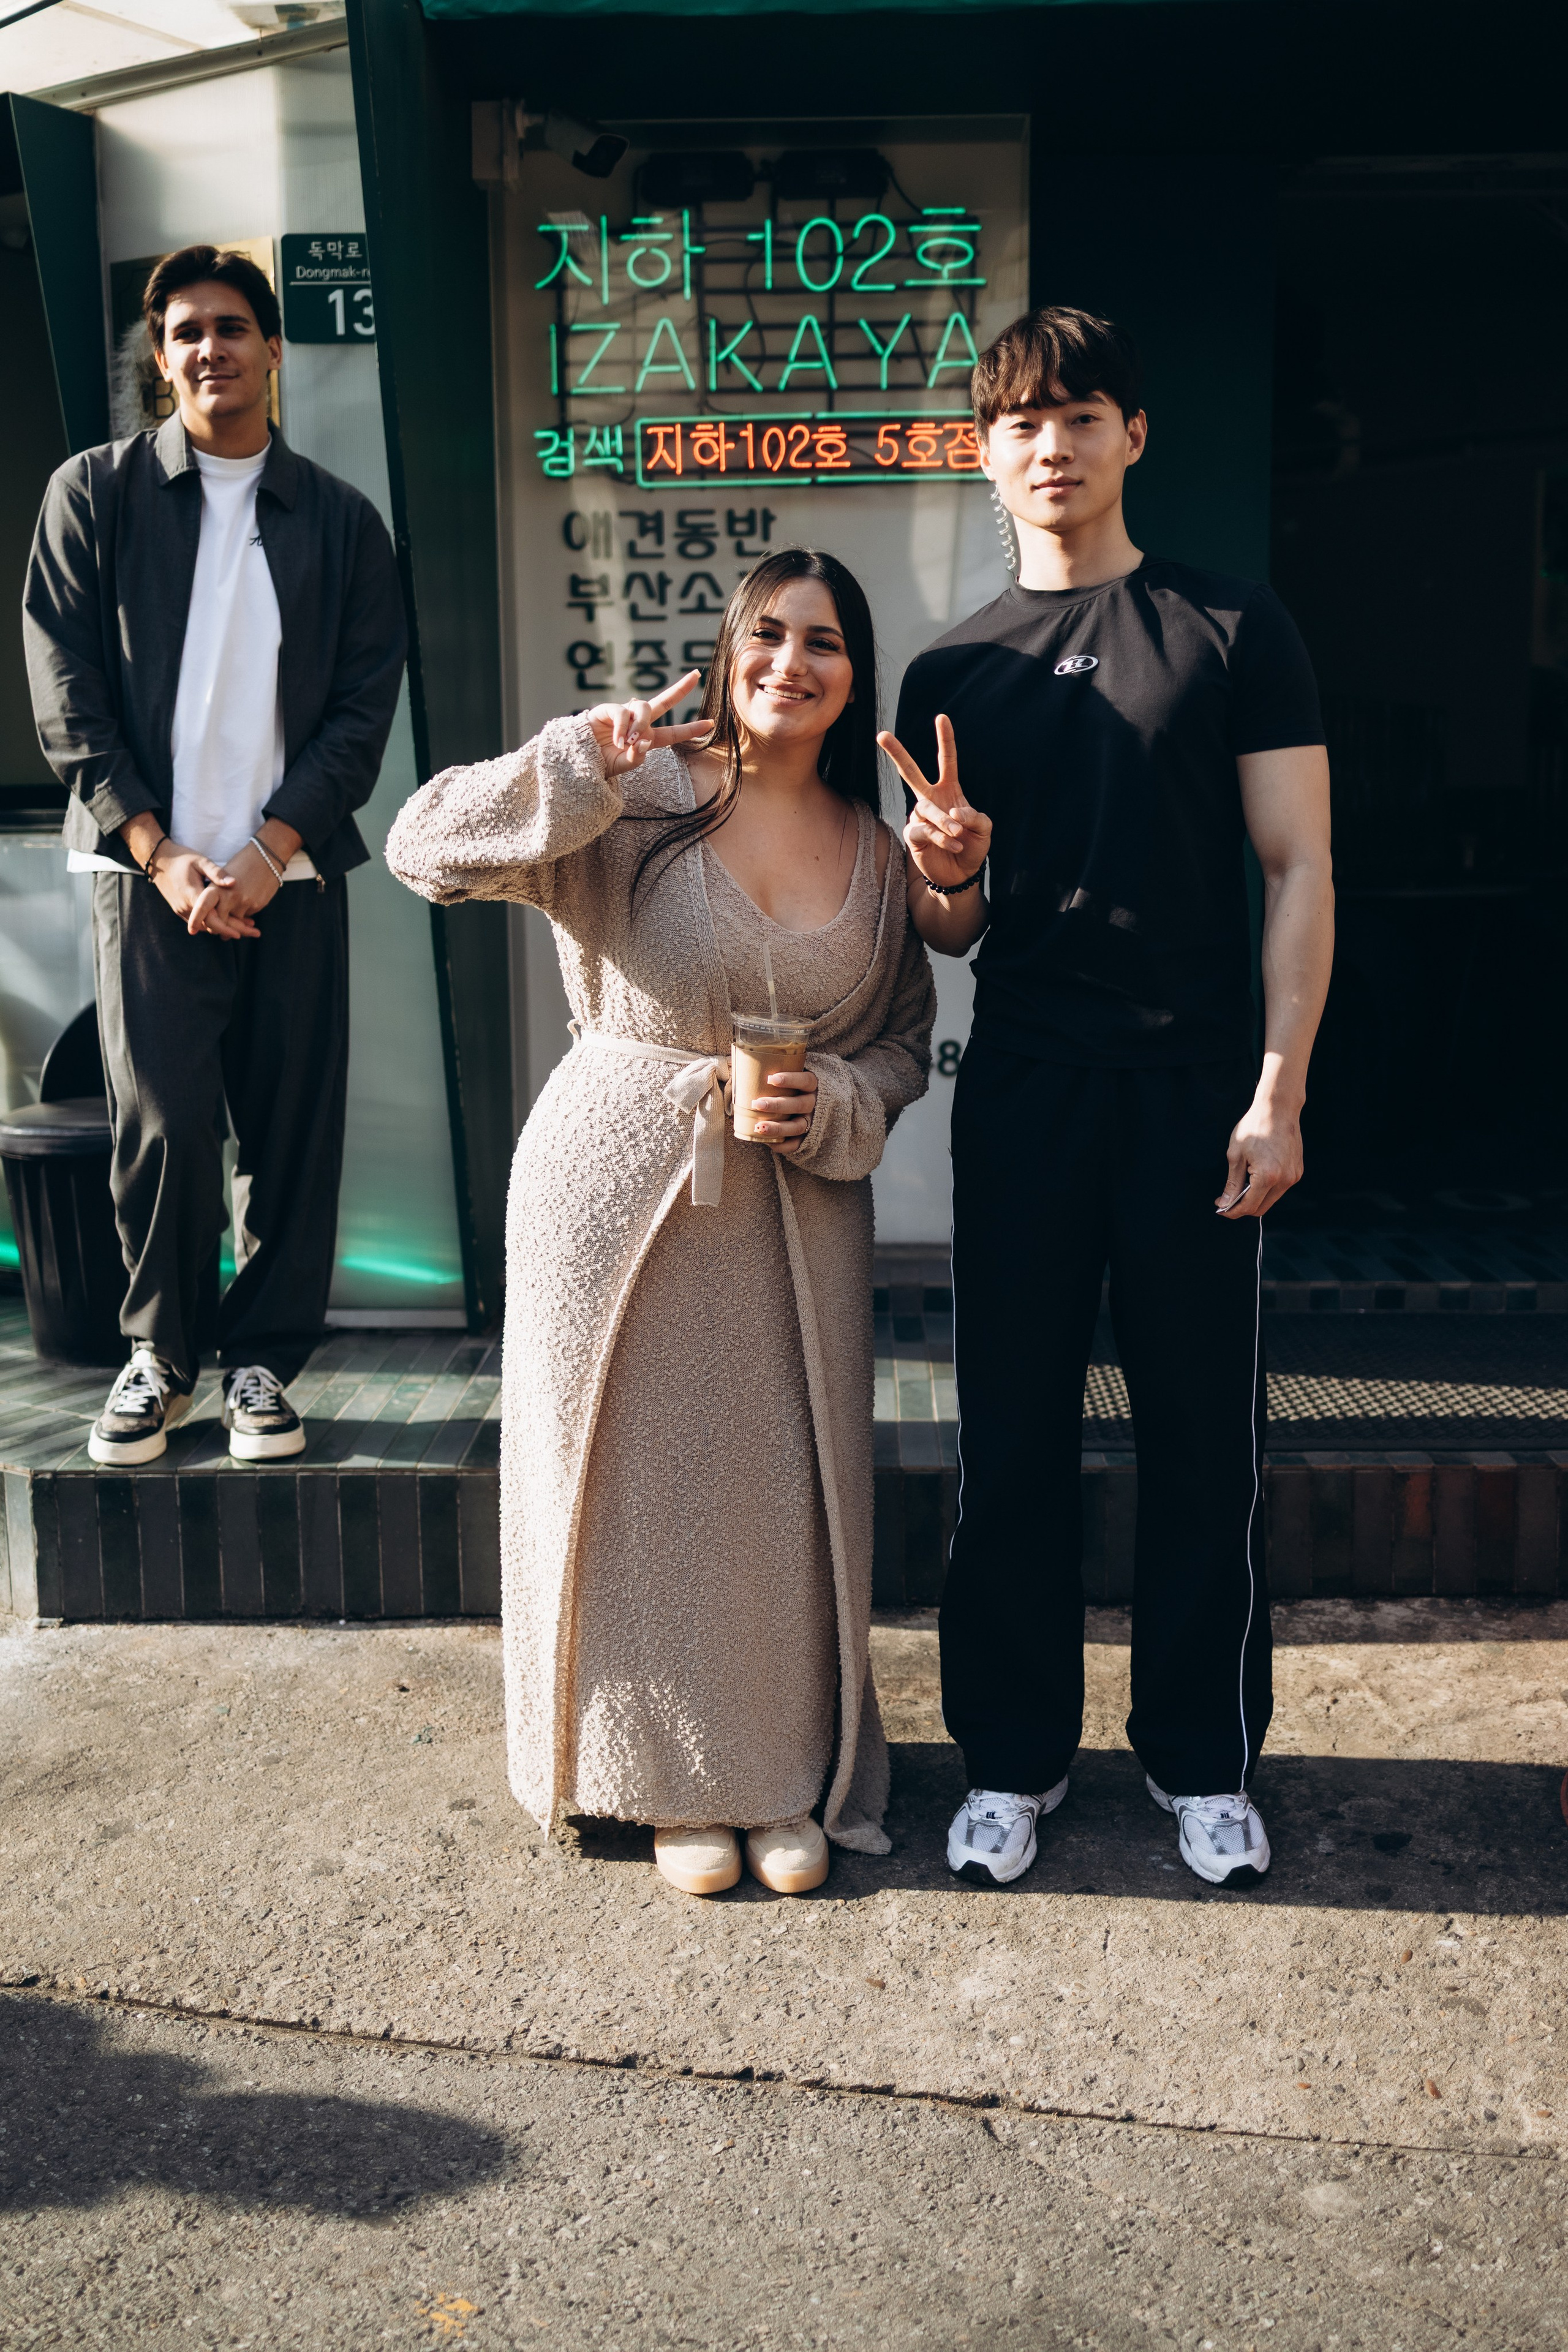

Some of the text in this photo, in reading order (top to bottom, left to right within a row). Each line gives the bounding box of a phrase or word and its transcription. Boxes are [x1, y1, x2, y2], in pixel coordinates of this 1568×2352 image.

[307, 240, 363, 262] 독막로
[535, 207, 987, 305] 지하 102호
[328, 288, 376, 336] 13
[550, 312, 979, 396] IZAKAYA
[533, 424, 624, 477] 검색
[646, 421, 851, 475] 지하102호
[562, 507, 777, 560] 애견동반
[566, 570, 748, 624] 부산소
